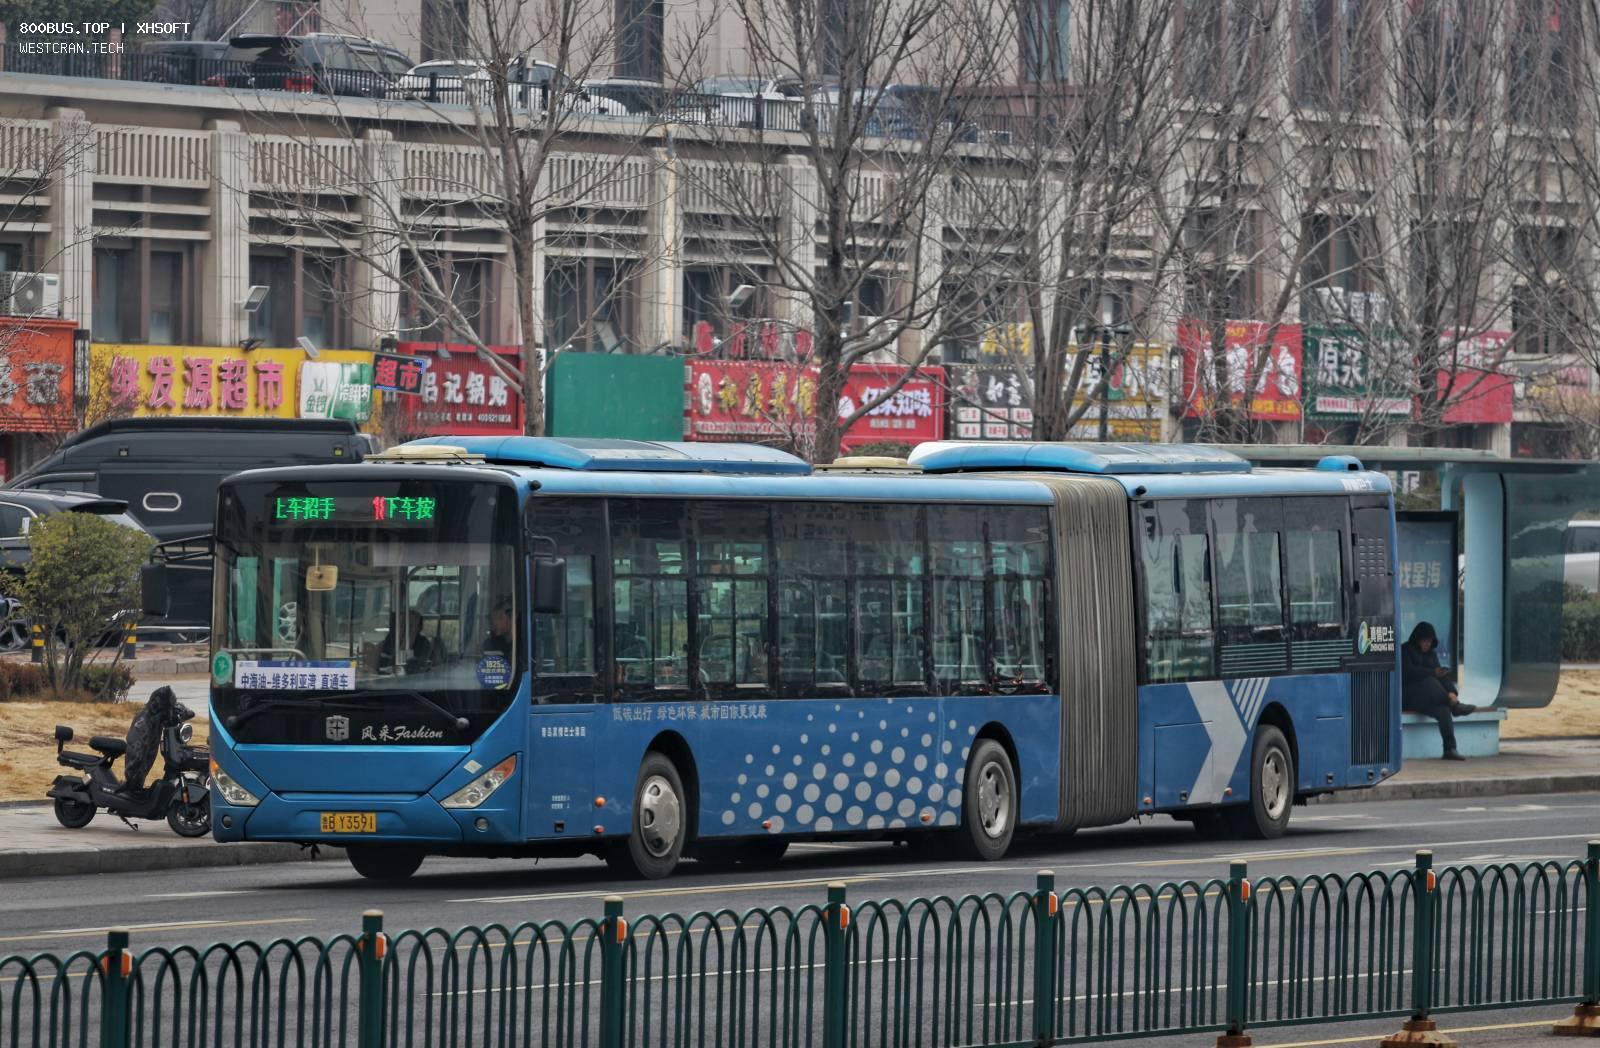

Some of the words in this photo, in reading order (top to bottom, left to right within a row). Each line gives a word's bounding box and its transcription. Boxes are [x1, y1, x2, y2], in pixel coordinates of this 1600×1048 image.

[375, 358, 420, 390] 超市
[384, 496, 435, 520] 下车按
[241, 672, 316, 689] 中海油-维多利亚湾
[320, 672, 348, 690] 直通车
[612, 706, 653, 721] 低碳出行
[656, 704, 697, 720] 绿色环保
[361, 725, 393, 741] 风采
[393, 725, 443, 741] Fashion
